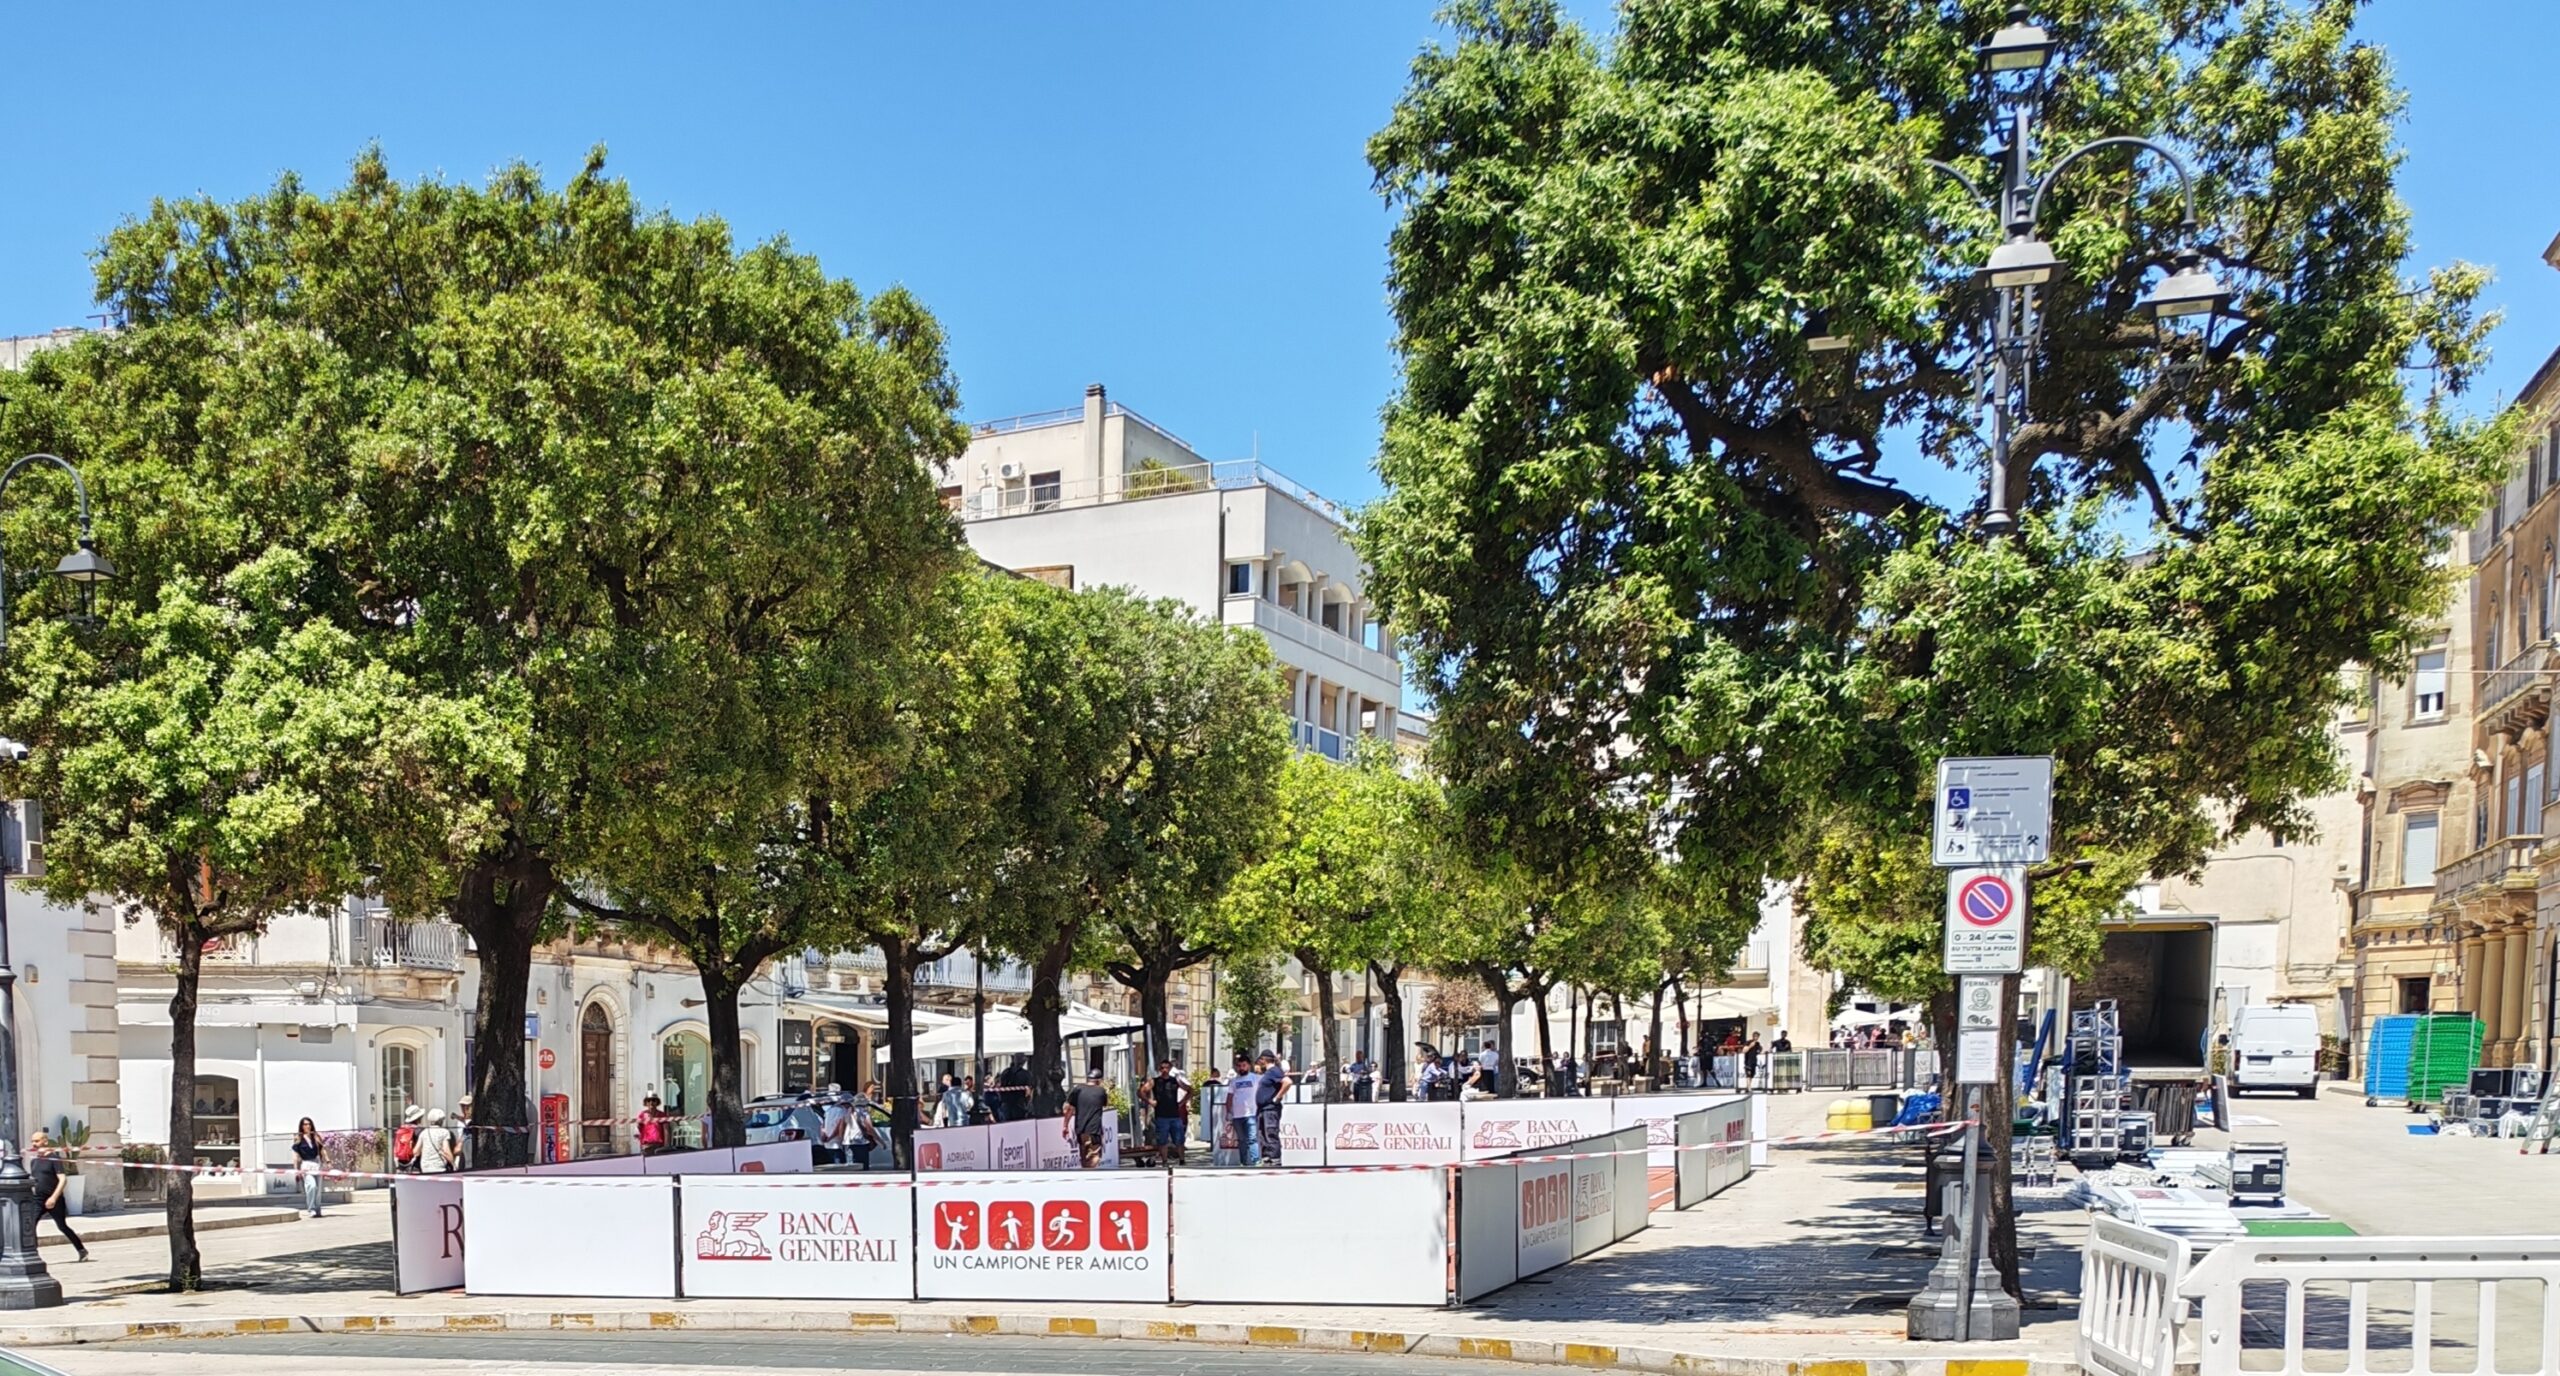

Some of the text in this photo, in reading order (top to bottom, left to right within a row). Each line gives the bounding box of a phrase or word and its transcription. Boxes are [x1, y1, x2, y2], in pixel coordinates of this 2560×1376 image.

[1384, 1122, 1431, 1136] BANCA
[1527, 1119, 1579, 1133] BANCA
[1384, 1137, 1452, 1150] GENERALI
[946, 1149, 975, 1163] ADRIANO
[1004, 1145, 1024, 1162] SPORT
[779, 1212, 861, 1235] BANCA
[779, 1239, 898, 1262] GENERALI
[934, 1256, 1149, 1271] UN CAMPIONE PER AMICO
